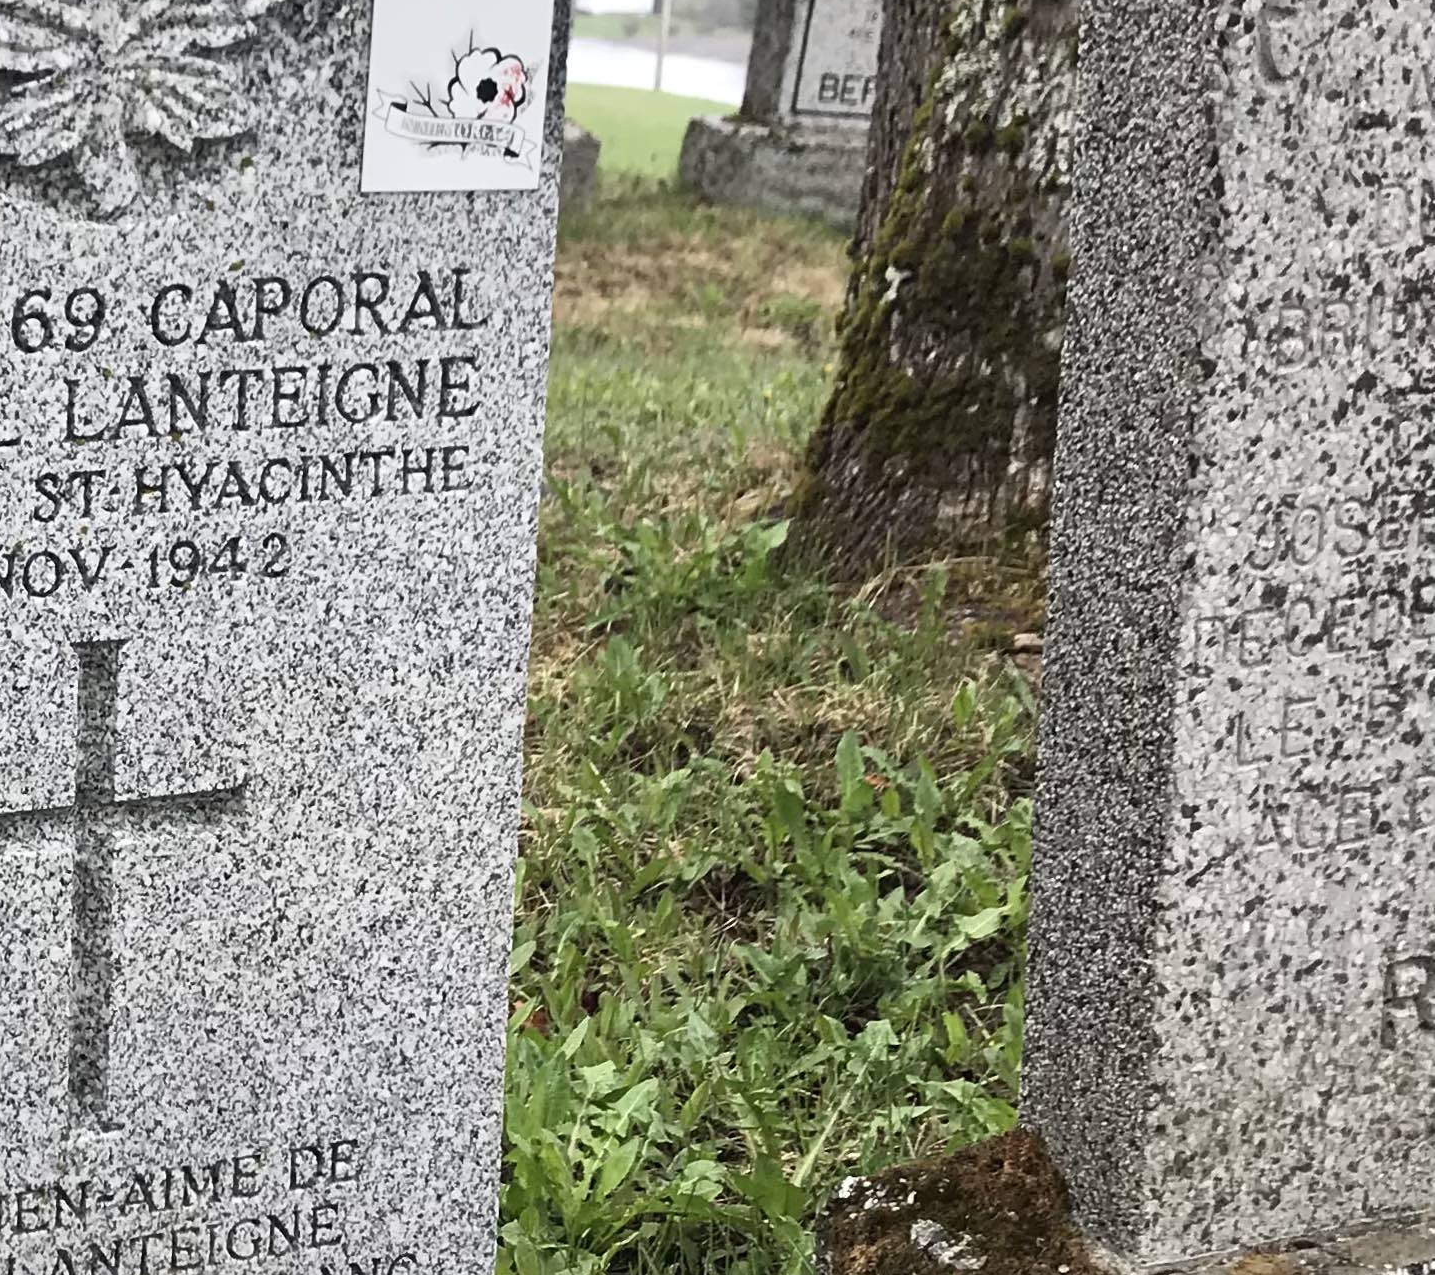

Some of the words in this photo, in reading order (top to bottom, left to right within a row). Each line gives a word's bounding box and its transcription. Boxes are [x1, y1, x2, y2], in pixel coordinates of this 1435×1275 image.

[148, 267, 489, 348] CAPORAL
[63, 355, 481, 443] LANTEIGNE
[289, 1139, 364, 1191] DE
